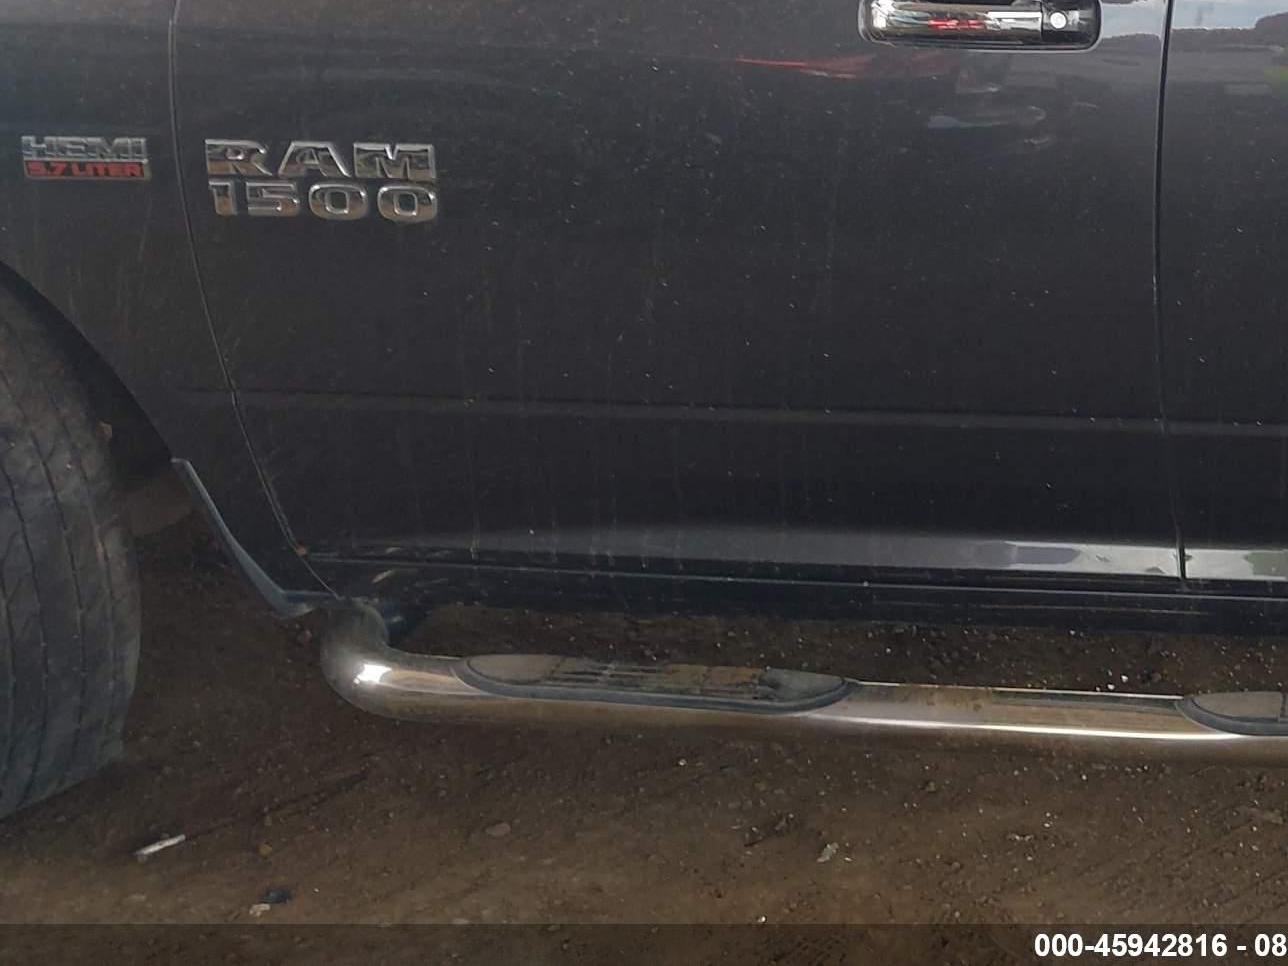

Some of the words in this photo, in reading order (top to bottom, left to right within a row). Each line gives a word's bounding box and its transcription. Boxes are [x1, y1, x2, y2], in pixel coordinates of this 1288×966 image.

[21, 135, 147, 161] HEMI
[205, 138, 436, 179] RAM
[25, 160, 68, 177] 5.7
[70, 161, 145, 178] LITER
[208, 179, 438, 222] 1500
